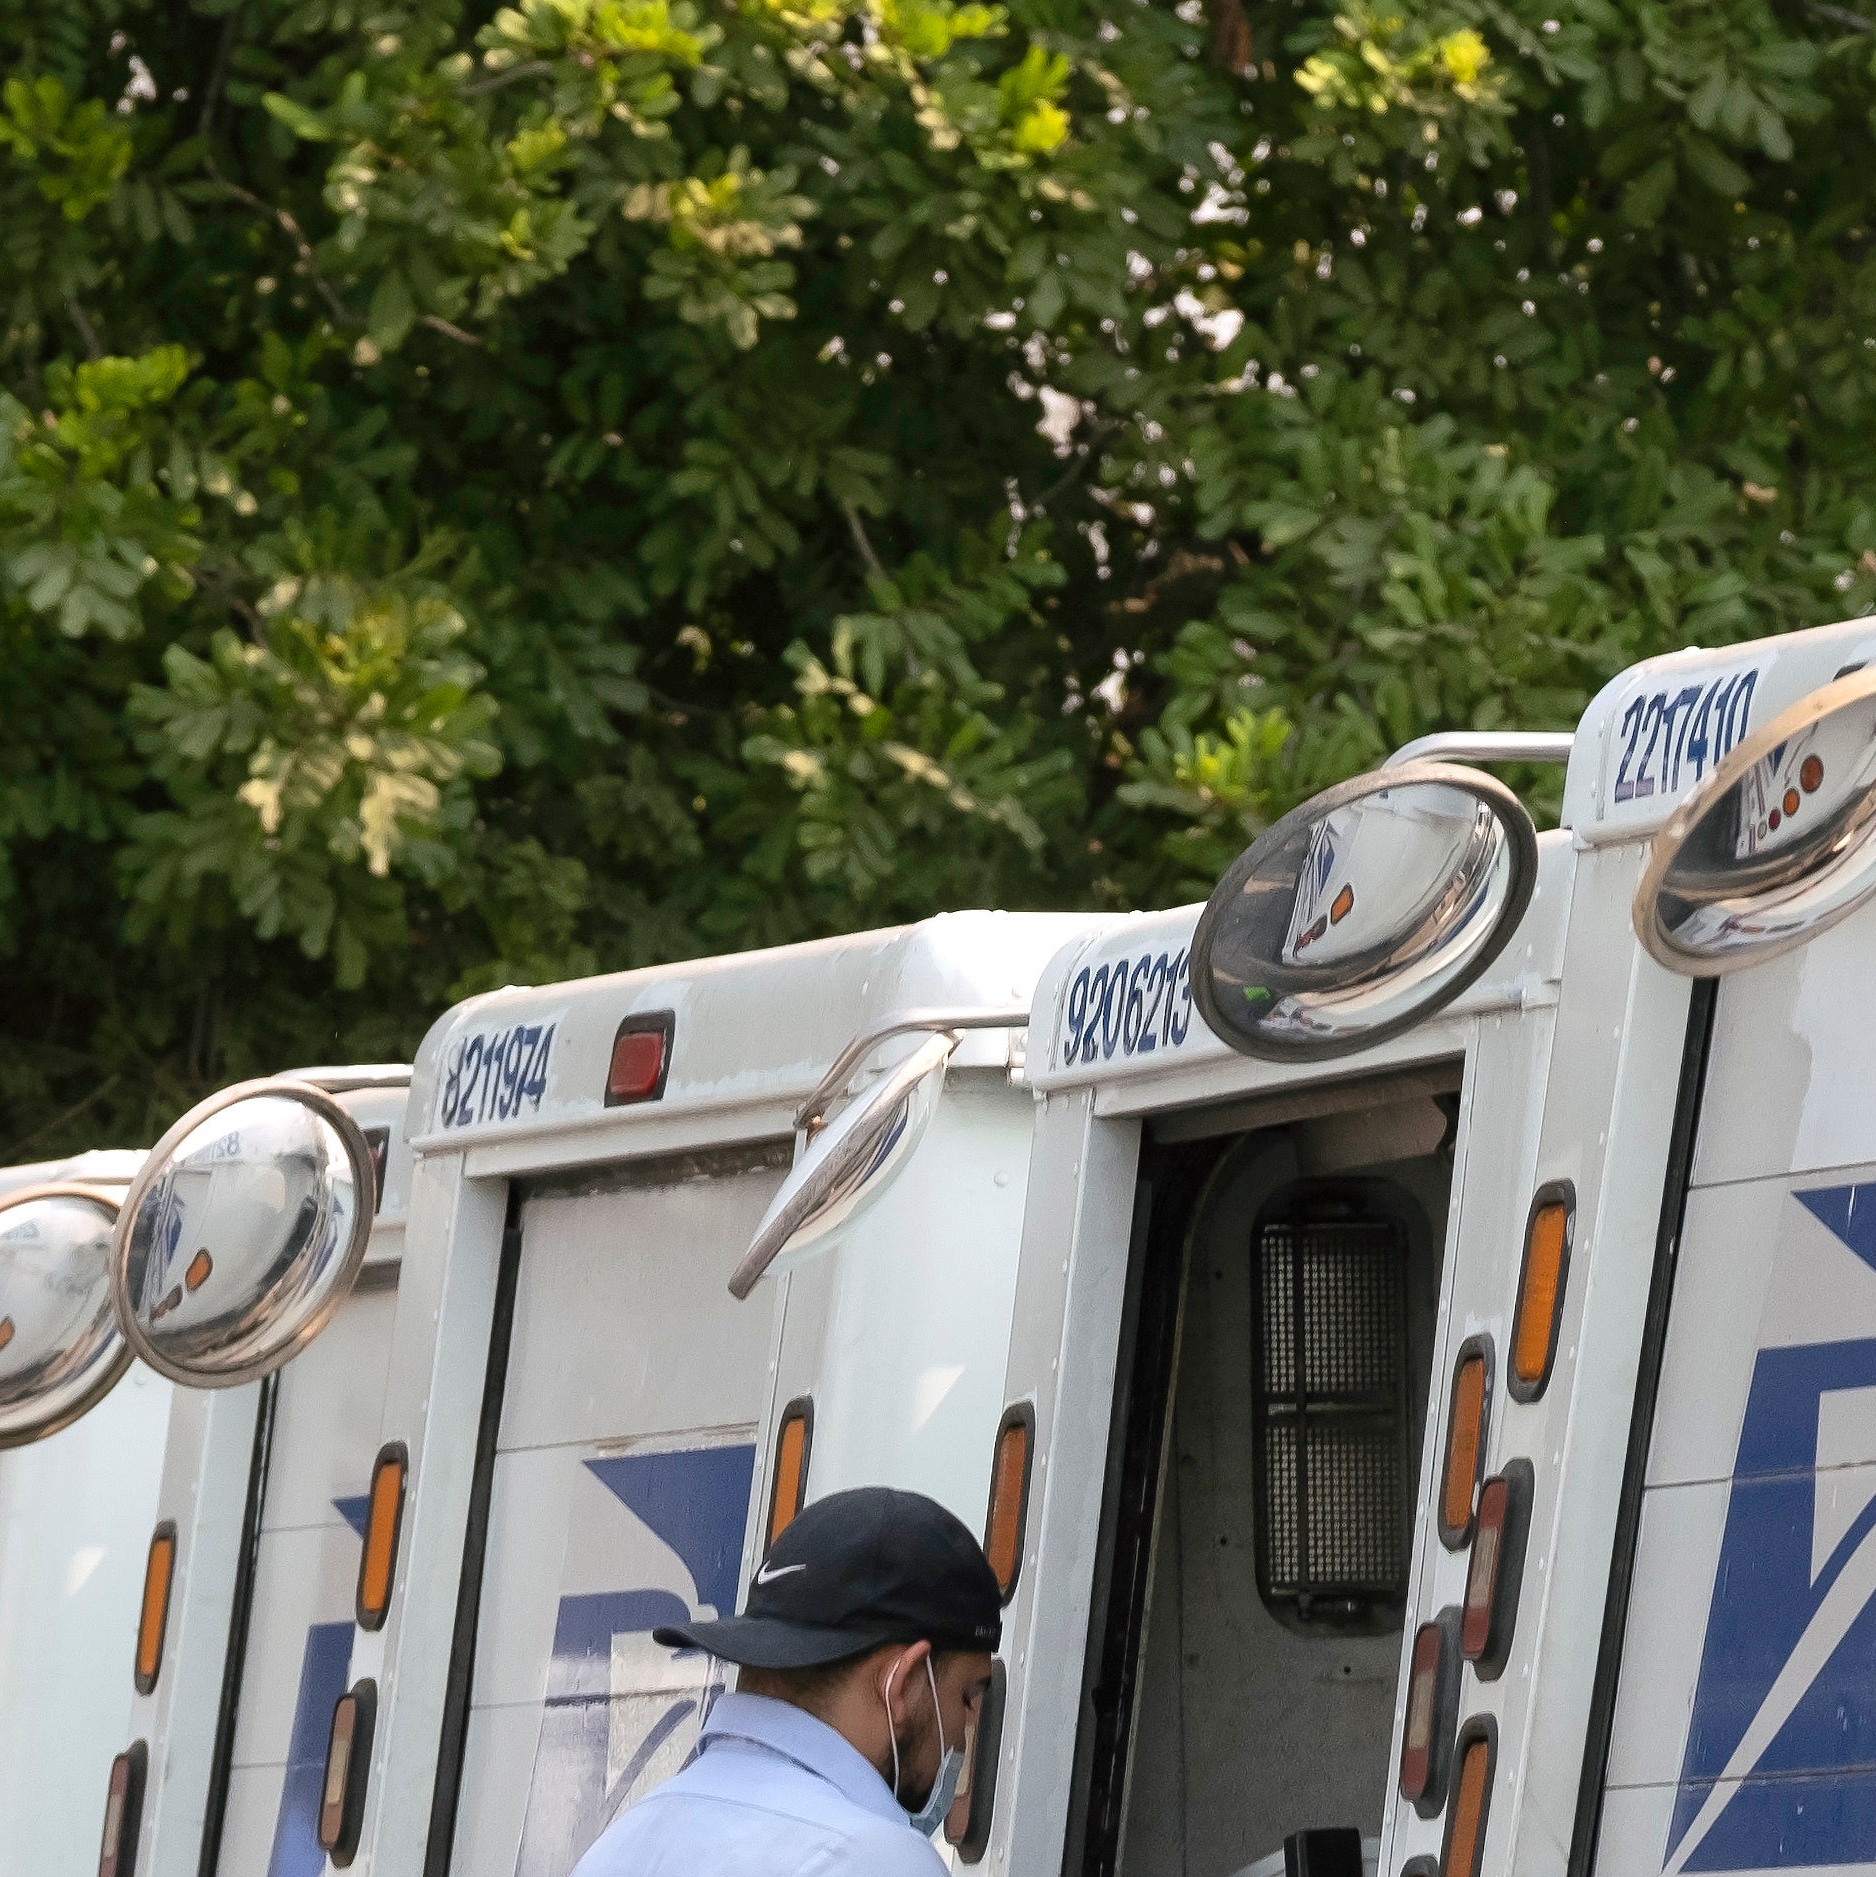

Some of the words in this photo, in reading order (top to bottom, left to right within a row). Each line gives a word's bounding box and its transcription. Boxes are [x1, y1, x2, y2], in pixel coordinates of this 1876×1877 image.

[1615, 668, 1759, 803] 2217410
[1064, 947, 1192, 1066] 9206213
[441, 1023, 556, 1128] 8211974
